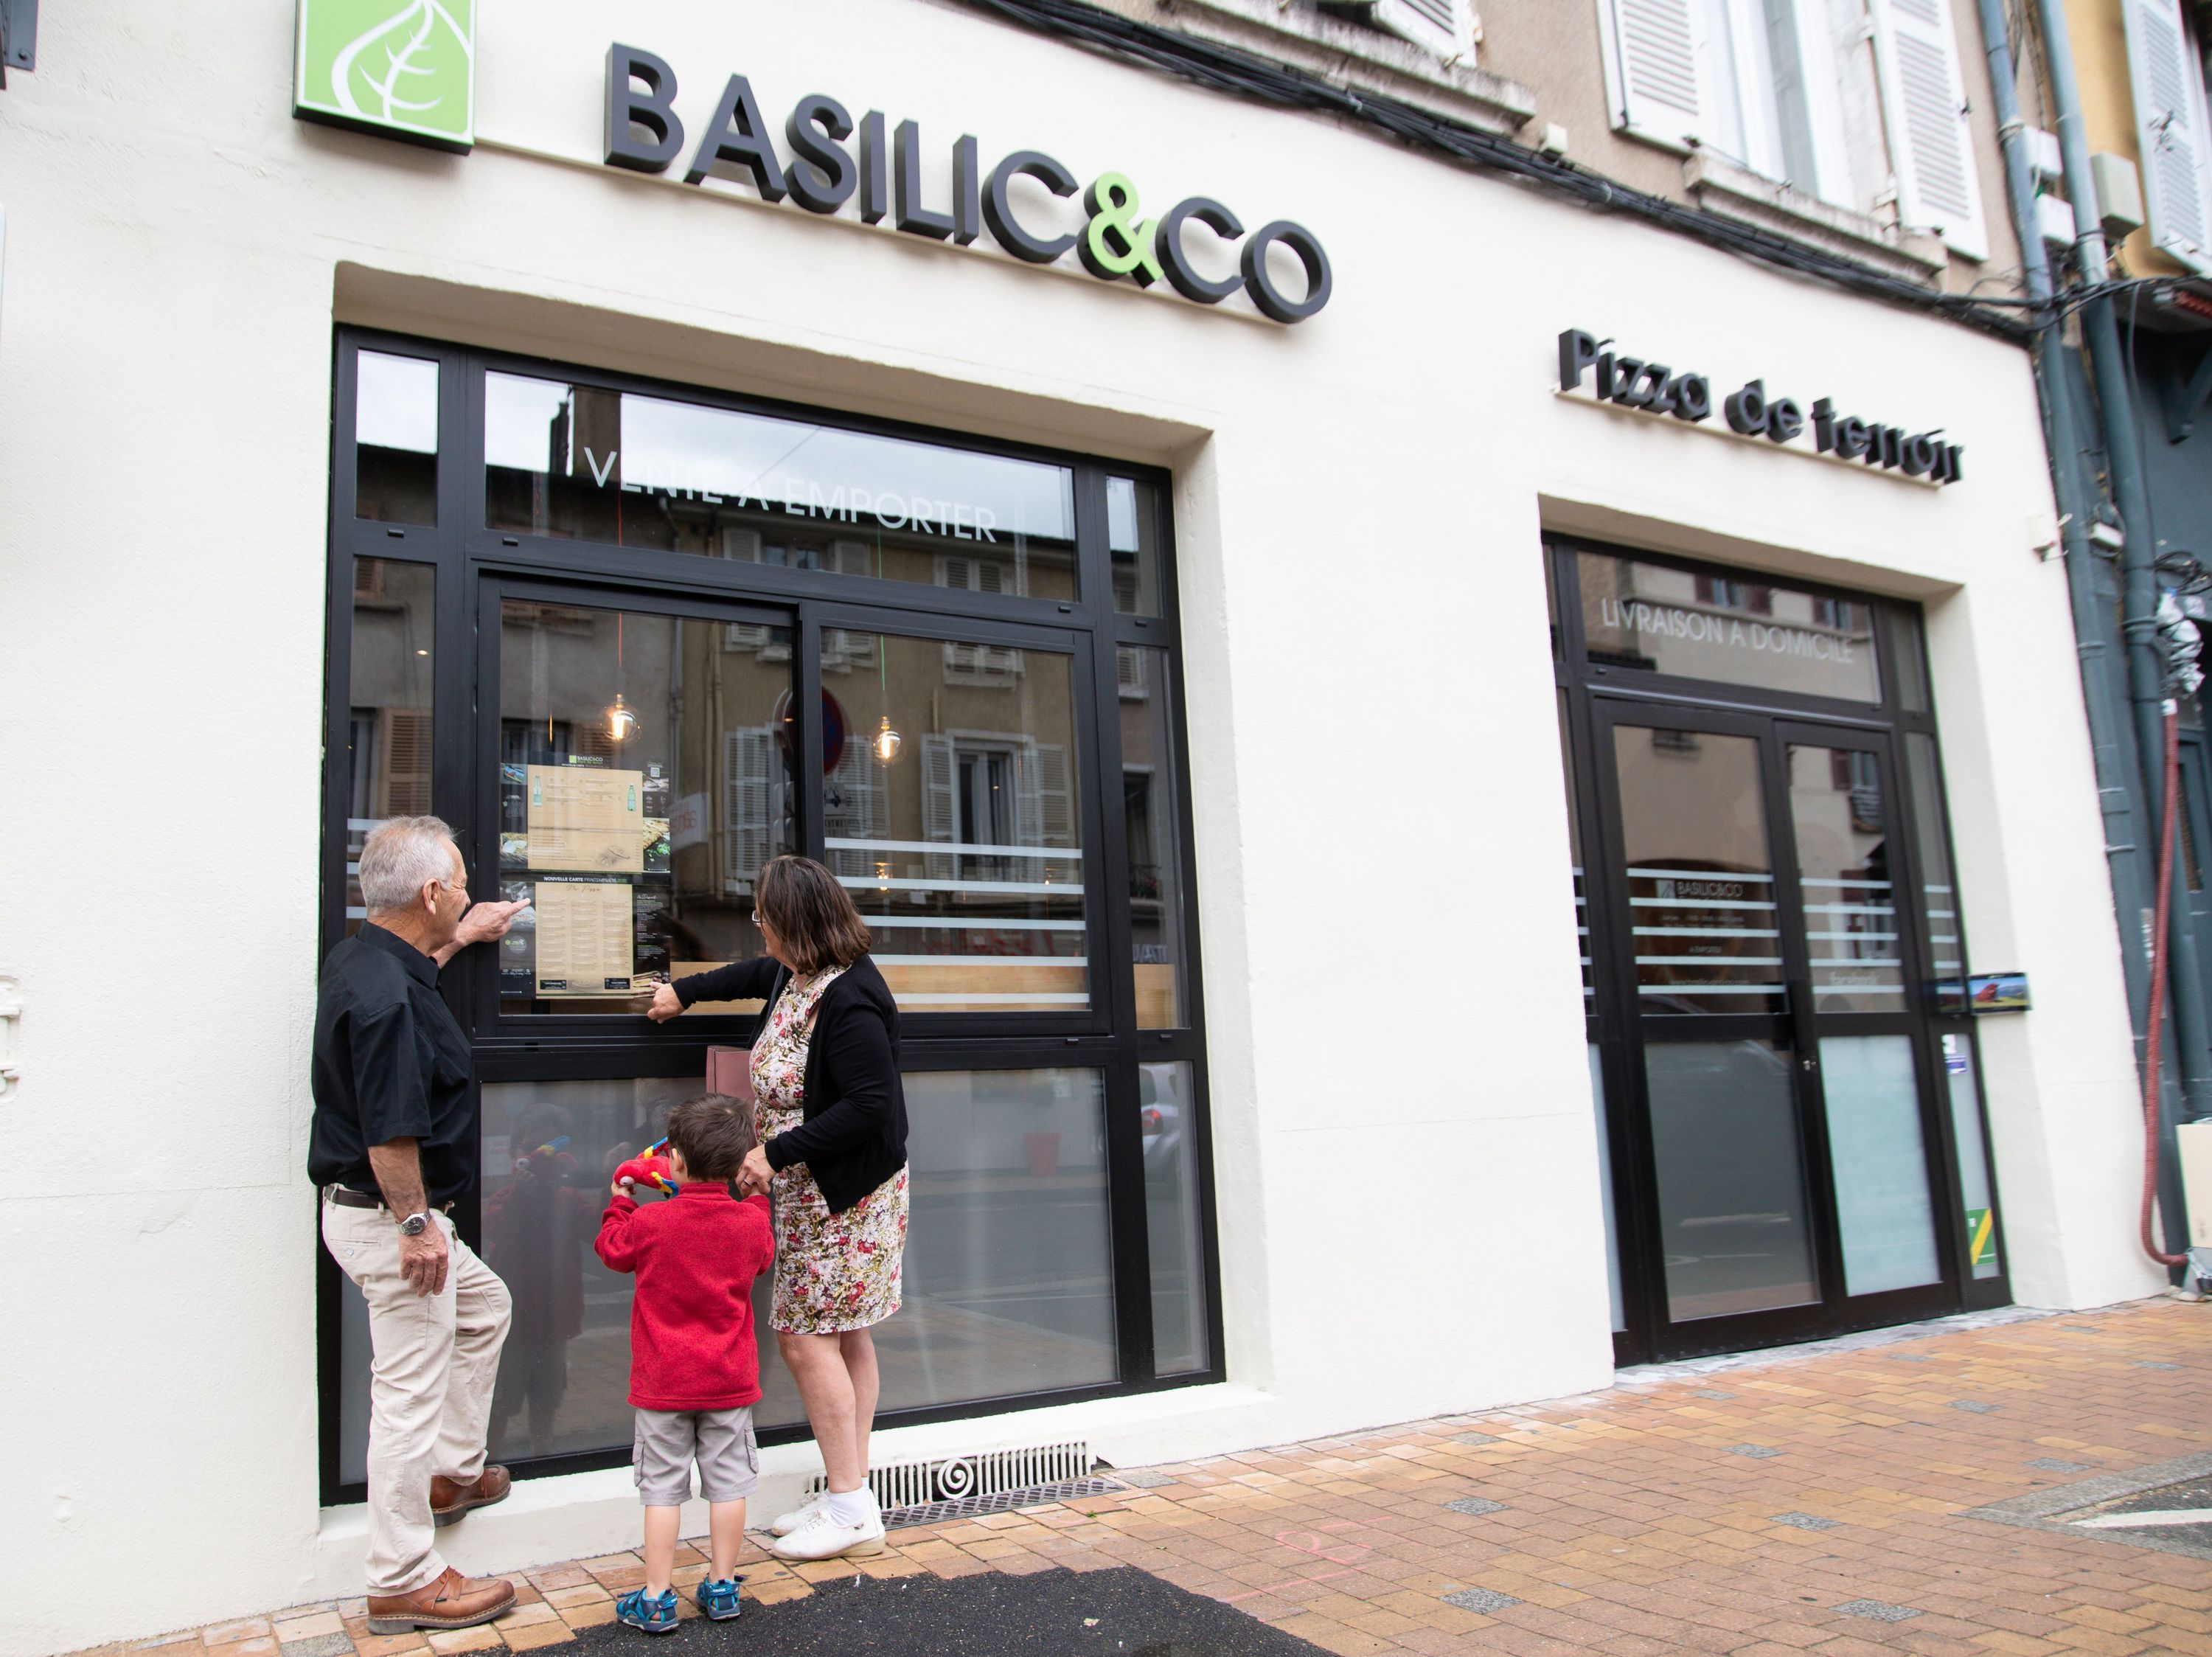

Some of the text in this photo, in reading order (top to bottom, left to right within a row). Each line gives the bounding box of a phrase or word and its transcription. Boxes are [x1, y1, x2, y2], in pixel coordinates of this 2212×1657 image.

[603, 41, 1332, 325] BASILIC&CO
[1557, 327, 1711, 422] Pizza
[1725, 378, 1803, 443] de
[785, 477, 997, 543] EMPORTER
[1601, 597, 1854, 664] LIVRAISON A DOMICILE
